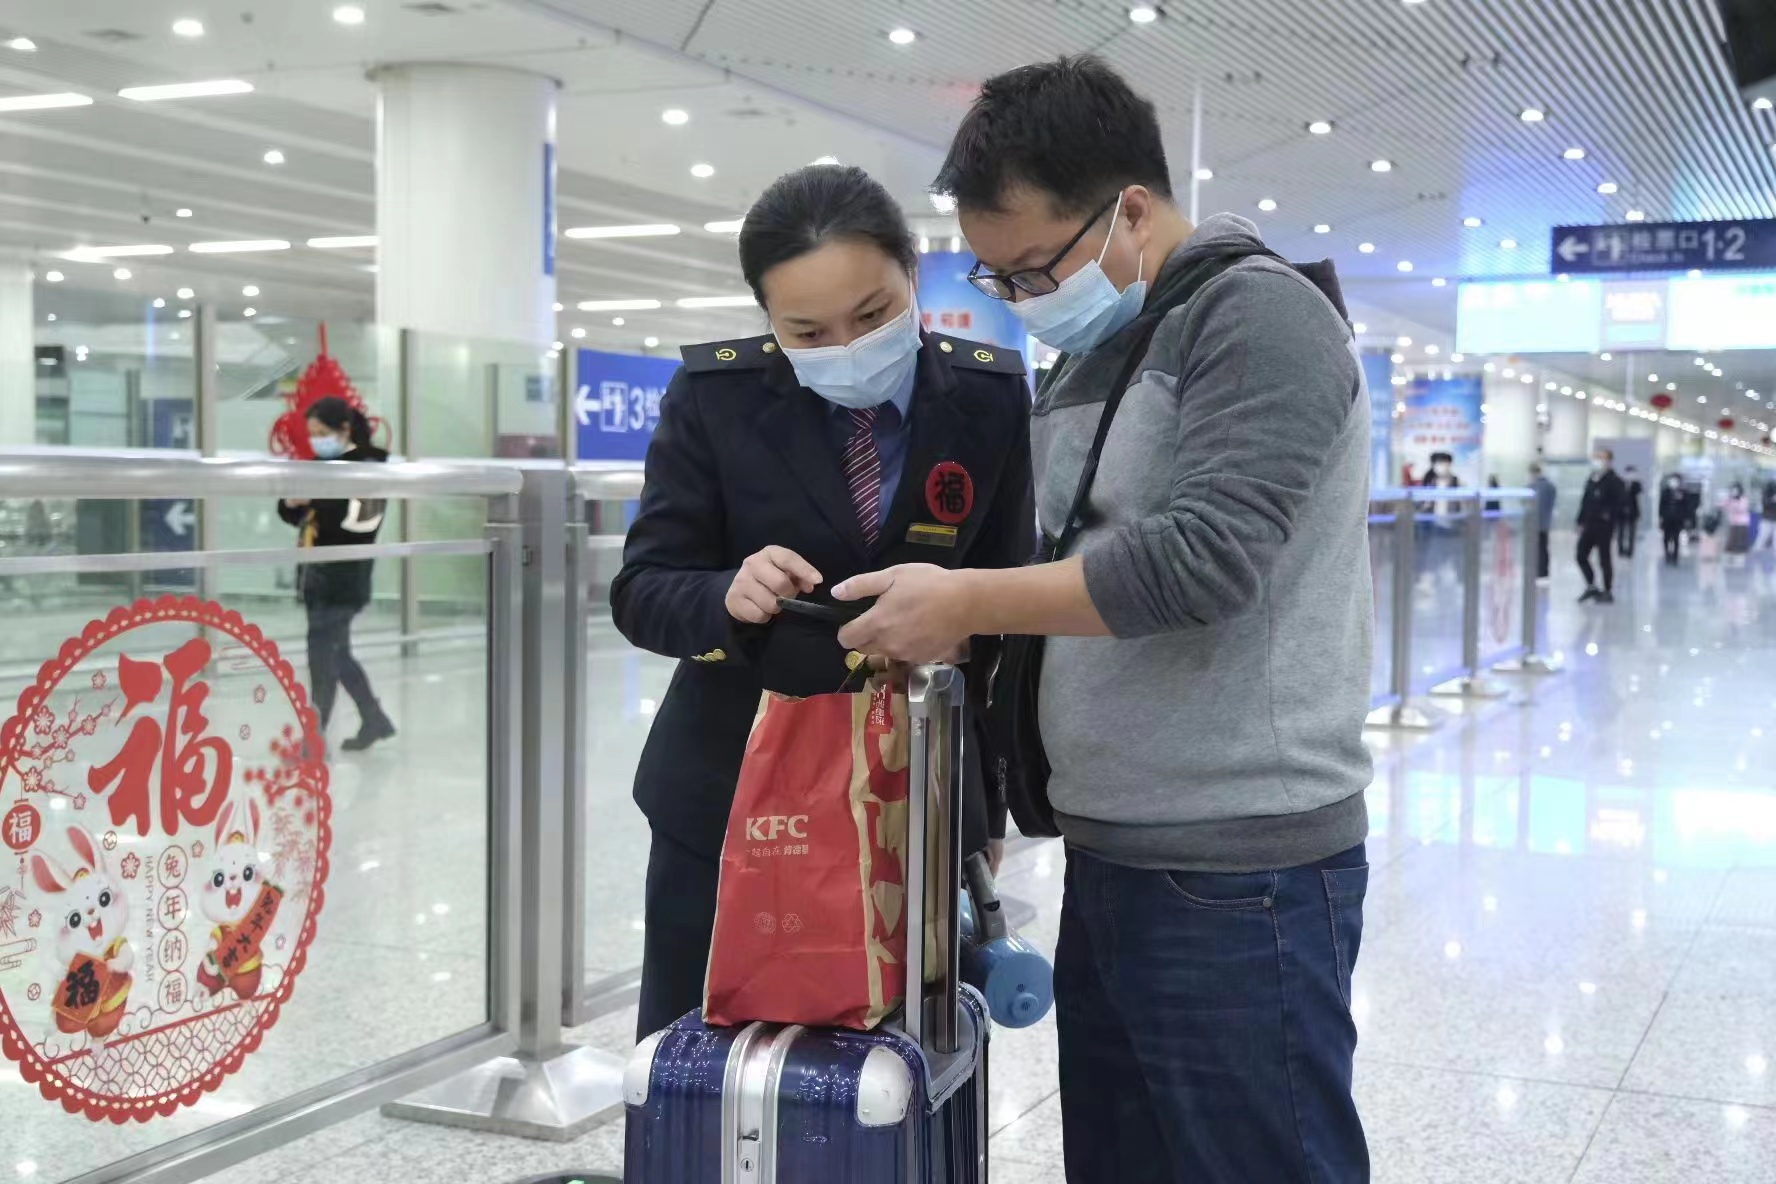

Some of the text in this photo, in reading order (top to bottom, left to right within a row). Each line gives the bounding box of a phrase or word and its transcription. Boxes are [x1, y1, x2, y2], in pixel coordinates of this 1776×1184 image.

[934, 471, 966, 514] 福
[88, 637, 233, 837] 福
[8, 810, 32, 846] 福
[746, 814, 809, 841] KFC
[783, 844, 809, 856] 肯德基
[145, 856, 154, 983] HAPPY NEW YEAR
[163, 854, 183, 1004] 兔年纳福
[65, 959, 100, 1010] 福
